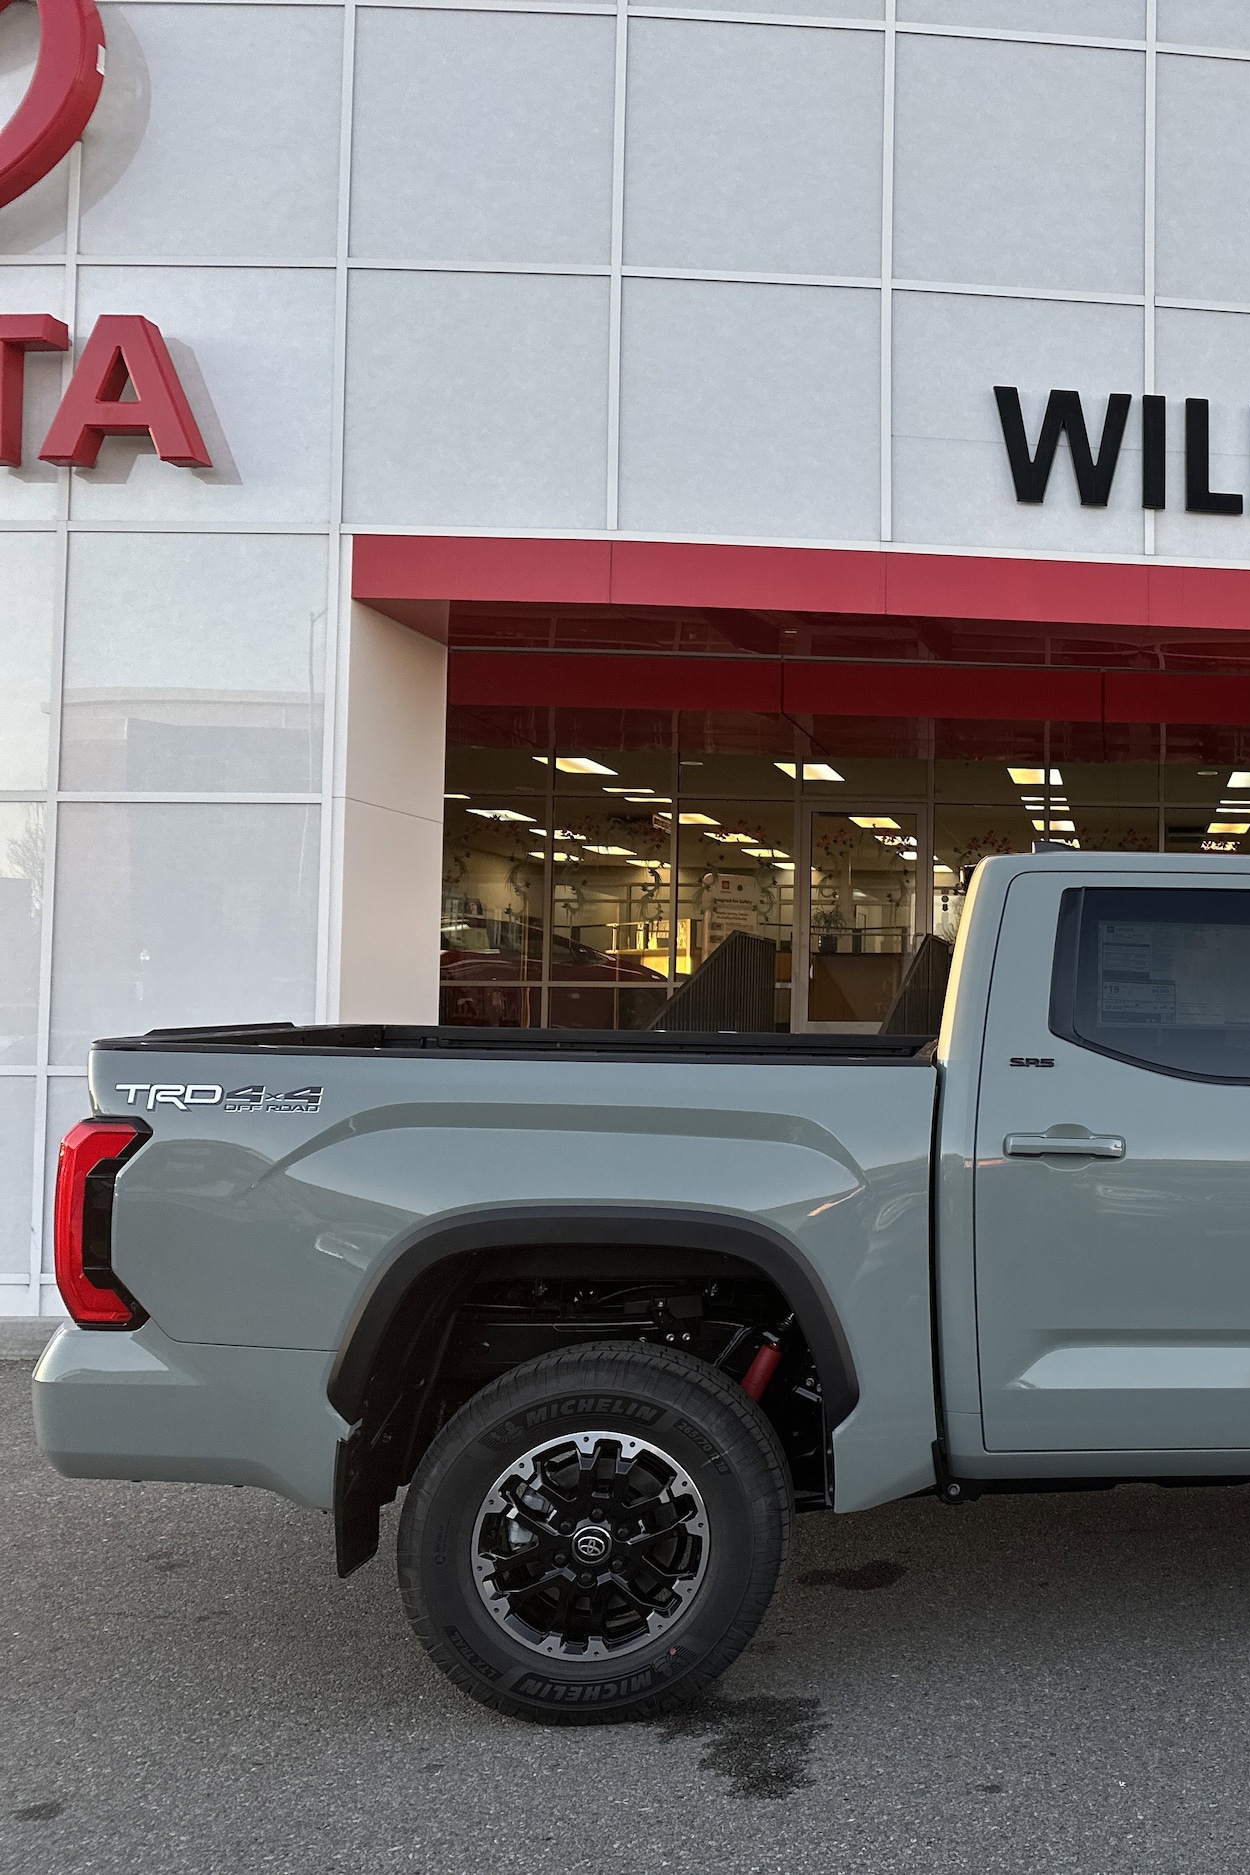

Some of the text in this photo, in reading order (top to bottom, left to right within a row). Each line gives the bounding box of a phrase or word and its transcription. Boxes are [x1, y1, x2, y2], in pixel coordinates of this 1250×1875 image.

[1009, 1057, 1055, 1068] SR5
[115, 1083, 324, 1112] TRD 4x4
[224, 1104, 321, 1113] OFF ROAD
[526, 1398, 657, 1425] MICHELIN
[471, 1653, 498, 1679] LTX
[521, 1671, 652, 1700] MICHELIN
